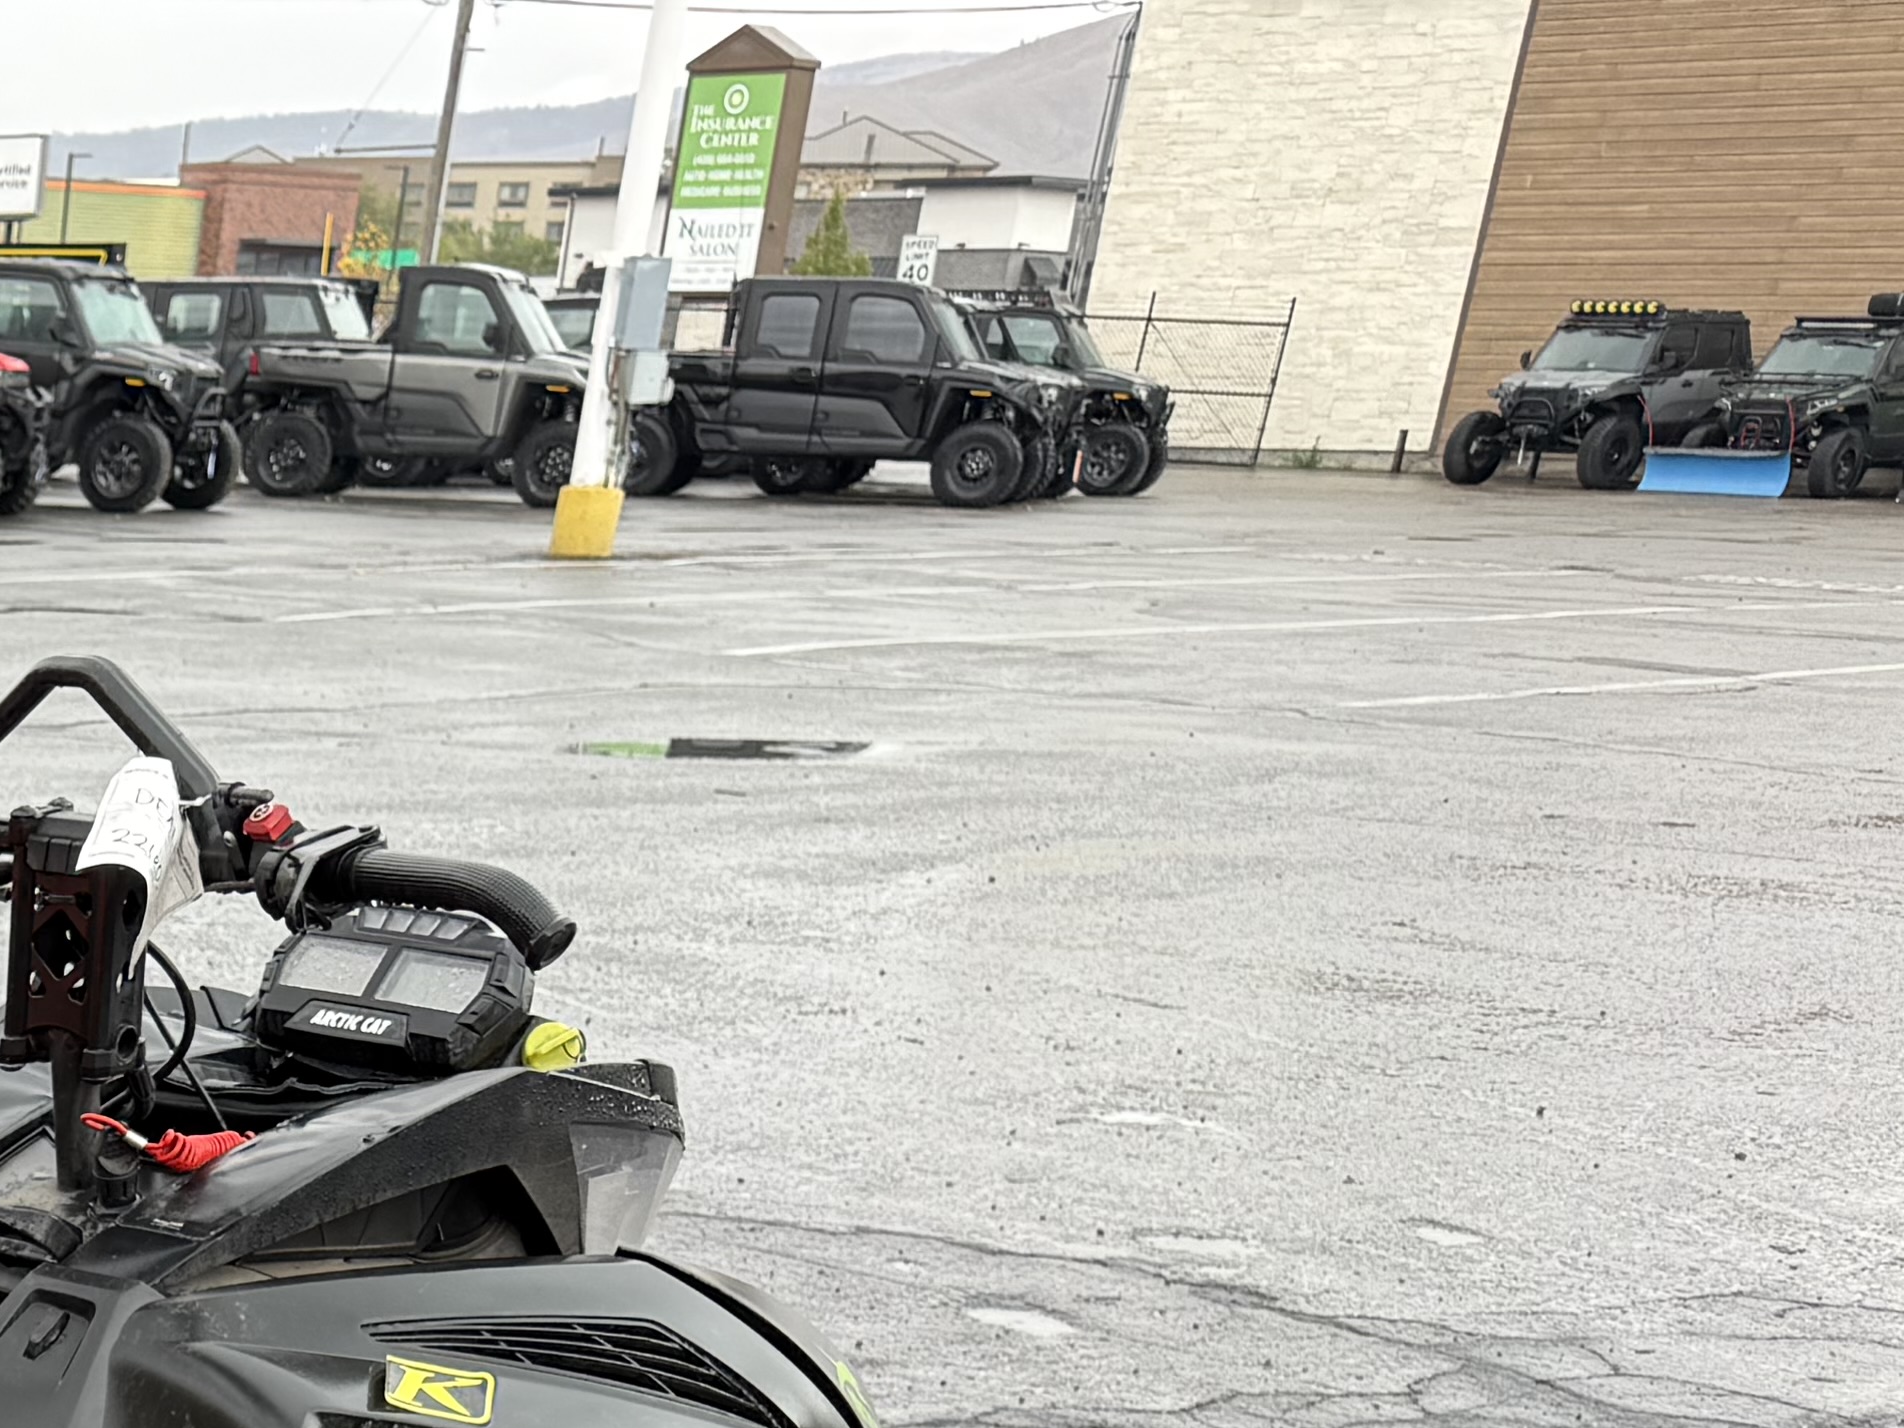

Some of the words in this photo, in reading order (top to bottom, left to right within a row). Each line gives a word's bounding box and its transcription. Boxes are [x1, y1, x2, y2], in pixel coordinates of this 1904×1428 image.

[689, 115, 775, 133] INSURANCE
[699, 132, 760, 149] CENTER
[902, 264, 929, 282] 40
[309, 1008, 359, 1031] ARCTIC
[360, 1016, 392, 1036] CAT
